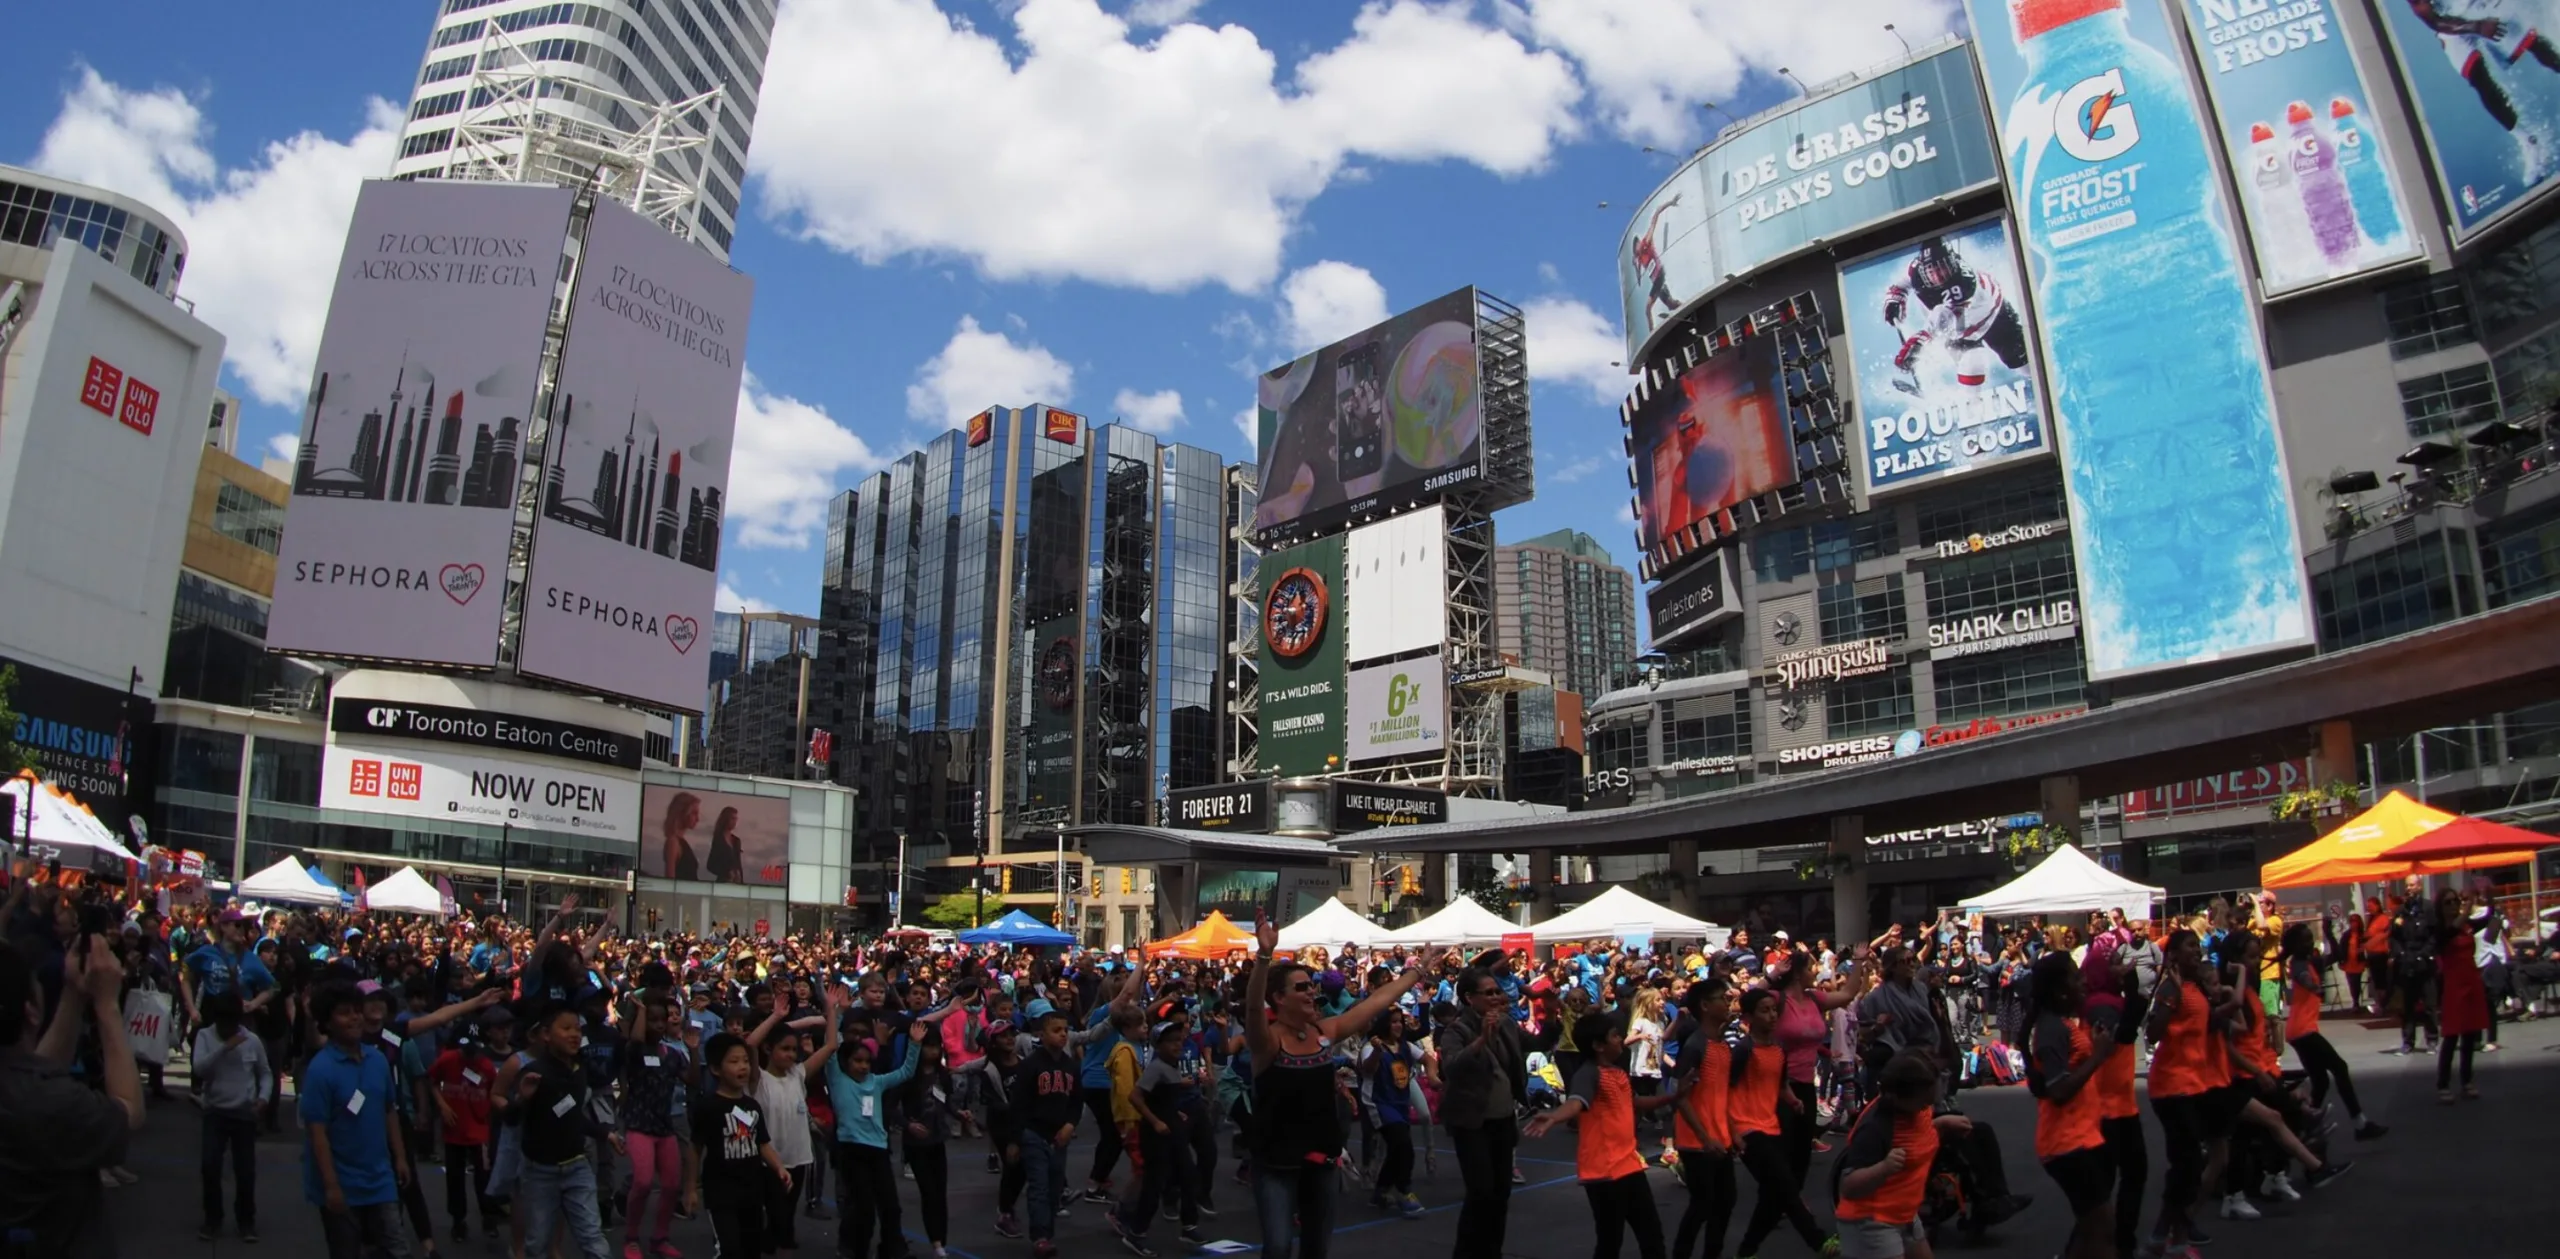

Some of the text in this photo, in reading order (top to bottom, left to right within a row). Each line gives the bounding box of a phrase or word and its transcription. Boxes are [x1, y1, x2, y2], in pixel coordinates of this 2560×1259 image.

[2208, 0, 2322, 45] GATORADE
[2214, 14, 2328, 74] FROST
[2054, 67, 2140, 162] G
[1734, 95, 1930, 198] DE GRASSE
[1738, 135, 1937, 231] PLAYS COOL
[2042, 165, 2103, 190] GATORADE
[2043, 163, 2142, 218] FROST
[2046, 195, 2132, 229] THIRST QUENCHER
[378, 233, 528, 258] 17 LOCATIONS
[353, 260, 537, 287] ACROSS THE GTA
[612, 264, 725, 336] 17 LOCATIONS
[1941, 285, 1963, 303] 29
[591, 285, 731, 368] ACROSS THE GTA
[130, 384, 153, 410] UNI
[126, 403, 151, 428] QLO
[1051, 412, 1076, 427] CIBC
[1871, 380, 2027, 450] POULIN
[1875, 421, 2034, 478] PLAYS COOL
[1424, 465, 1477, 492] SAMSUNG
[1350, 499, 1377, 514] 12:13 PM
[1935, 522, 2051, 558] The Beer Store
[295, 561, 429, 591] SEPHORA
[547, 587, 658, 637] SEPHORA
[1658, 584, 1714, 625] milestones
[1928, 600, 2074, 647] SHARK CLUB
[1776, 641, 1867, 663] LOUNGE RESTAURANT
[1952, 630, 2050, 656] SPORTS BAR GRILL
[1460, 667, 1503, 681] Clear Channel
[1265, 681, 1333, 704] IT'S A WILD RIDE.
[367, 707, 619, 758] CF Toronto Eaton Centre
[1273, 712, 1325, 732] FALLSVIEW CASINO
[1273, 725, 1324, 739] NIAGARA FALLS
[1380, 715, 1420, 732] MILLION
[14, 712, 132, 764] SAMSUN
[1370, 728, 1420, 745] MAXMILLIONS
[1780, 736, 1891, 763] SHOPPERS
[1672, 755, 1734, 771] milestones
[1823, 751, 1891, 768] DRUG MART
[81, 776, 117, 796] SOON
[392, 767, 416, 782] UNI
[390, 782, 417, 796] QLO
[471, 770, 605, 813] NOW OPEN
[1182, 795, 1233, 820] FOREVER
[1239, 793, 1252, 814] 21
[1346, 794, 1363, 809] LIKE
[1374, 796, 1395, 811] WEAR
[1405, 800, 1428, 815] SHARE
[1298, 878, 1330, 887] DUNDAS
